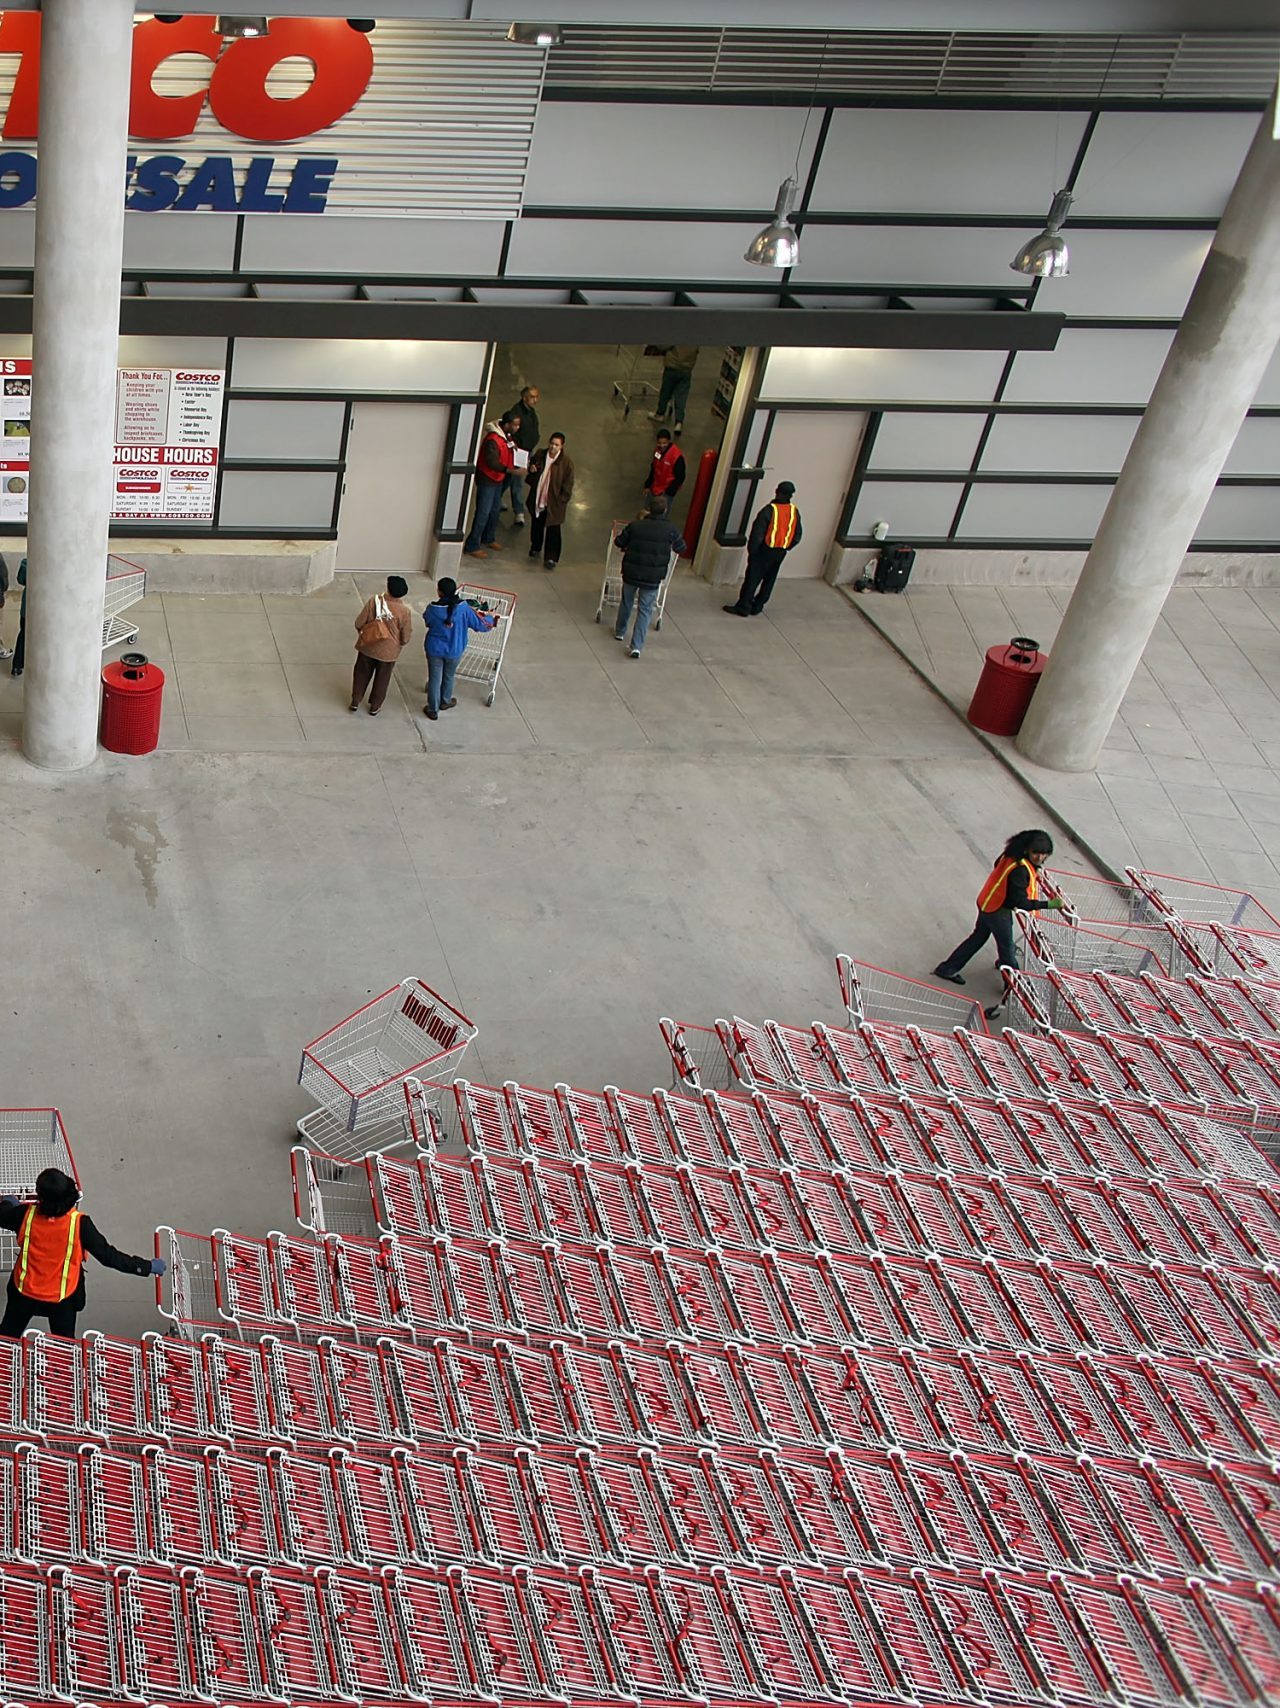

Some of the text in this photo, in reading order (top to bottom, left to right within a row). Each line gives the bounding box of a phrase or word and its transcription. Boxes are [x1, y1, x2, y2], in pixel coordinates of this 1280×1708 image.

[122, 372, 139, 380] Thank
[141, 372, 151, 380] You
[175, 372, 221, 381] COSTCO
[164, 448, 213, 463] HOURS
[119, 469, 159, 477] COSTCO
[170, 469, 210, 478] COSTCO
